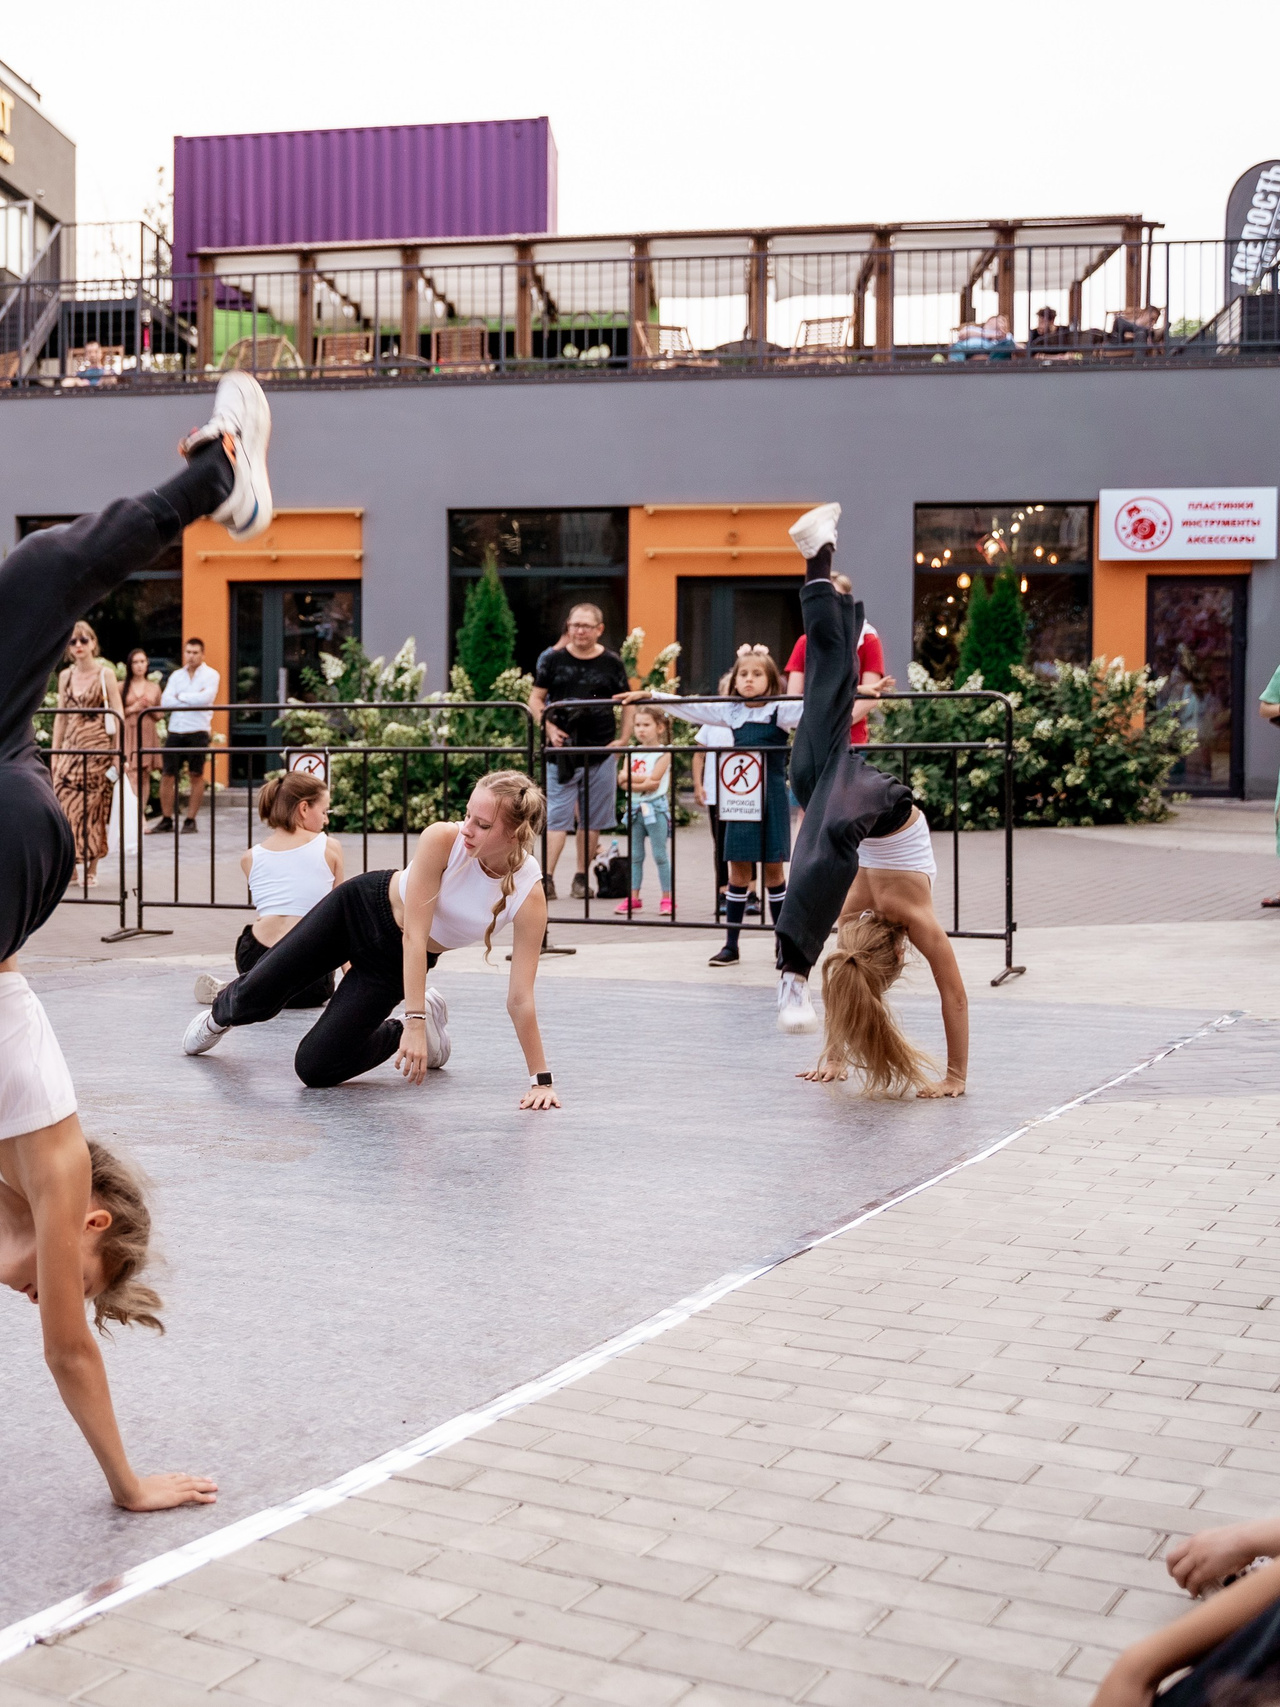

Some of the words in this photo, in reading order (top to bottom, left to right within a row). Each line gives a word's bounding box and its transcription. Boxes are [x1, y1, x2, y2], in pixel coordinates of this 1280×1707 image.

[1188, 502, 1254, 511] ПЛАСТИНКИ
[1181, 519, 1261, 528] ИНСТРУМЕНТЫ
[1186, 535, 1256, 545] АКСЕССУАРЫ
